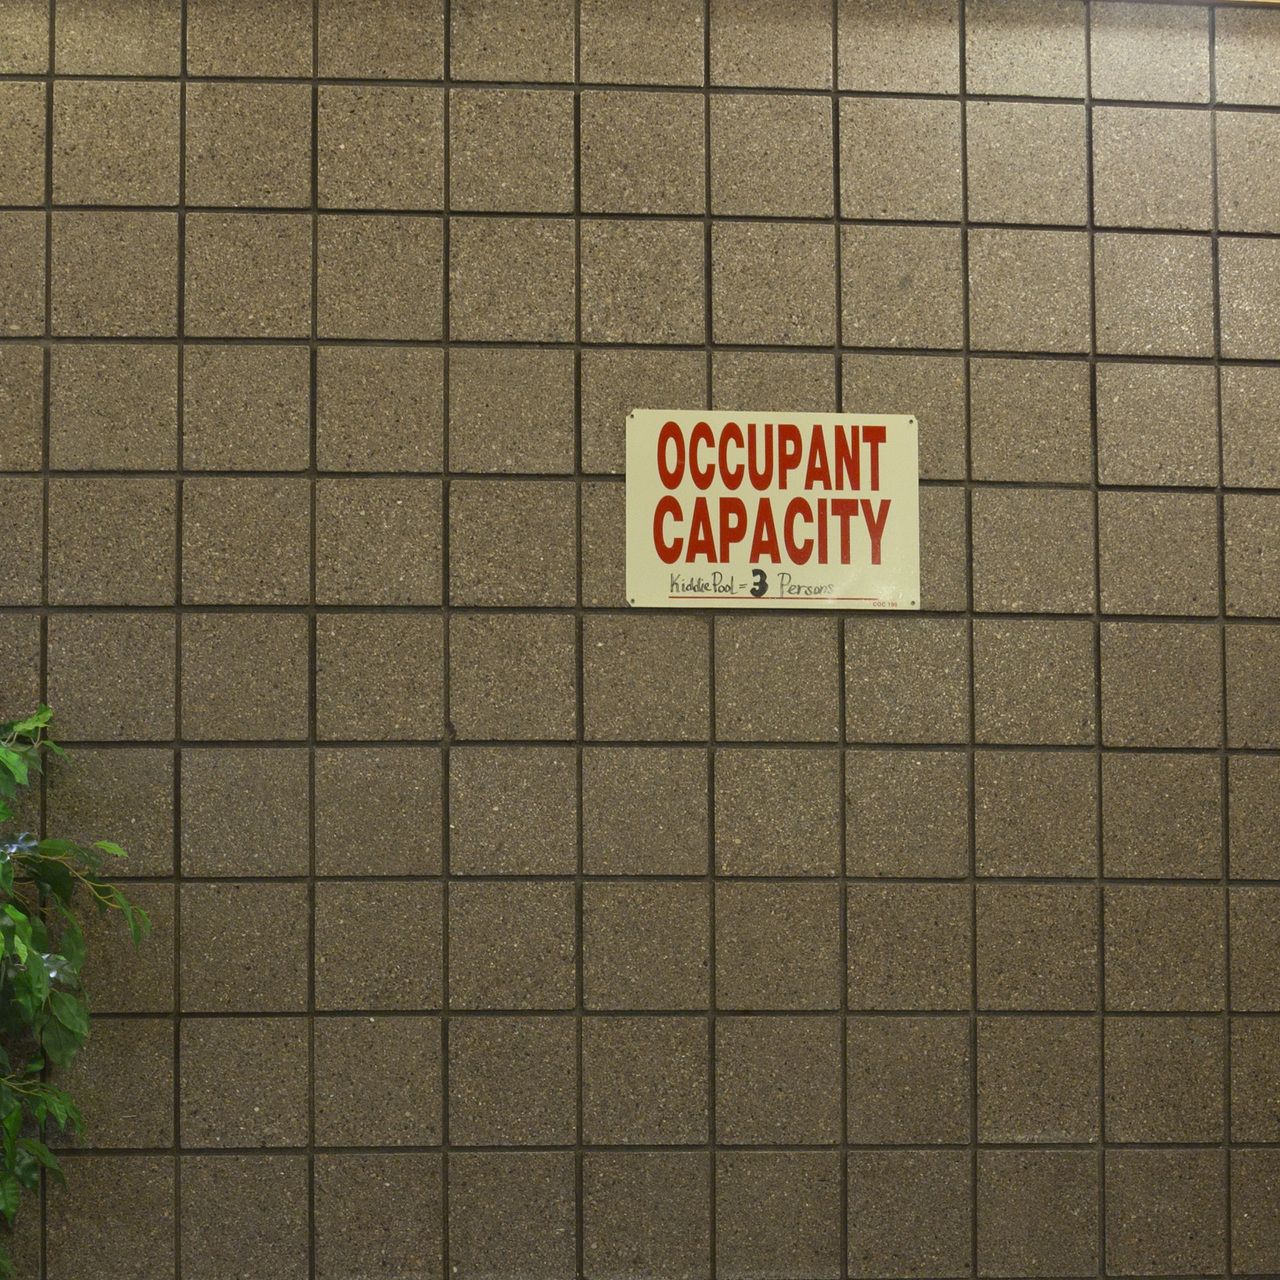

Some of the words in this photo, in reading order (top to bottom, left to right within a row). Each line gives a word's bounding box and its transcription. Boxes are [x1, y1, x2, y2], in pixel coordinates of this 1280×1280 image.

[657, 421, 887, 491] OCCUPANT
[653, 495, 892, 565] CAPACITY
[670, 573, 712, 593] Kiddie
[711, 571, 738, 595] Pool
[750, 568, 769, 598] 3
[777, 572, 835, 597] Persons
